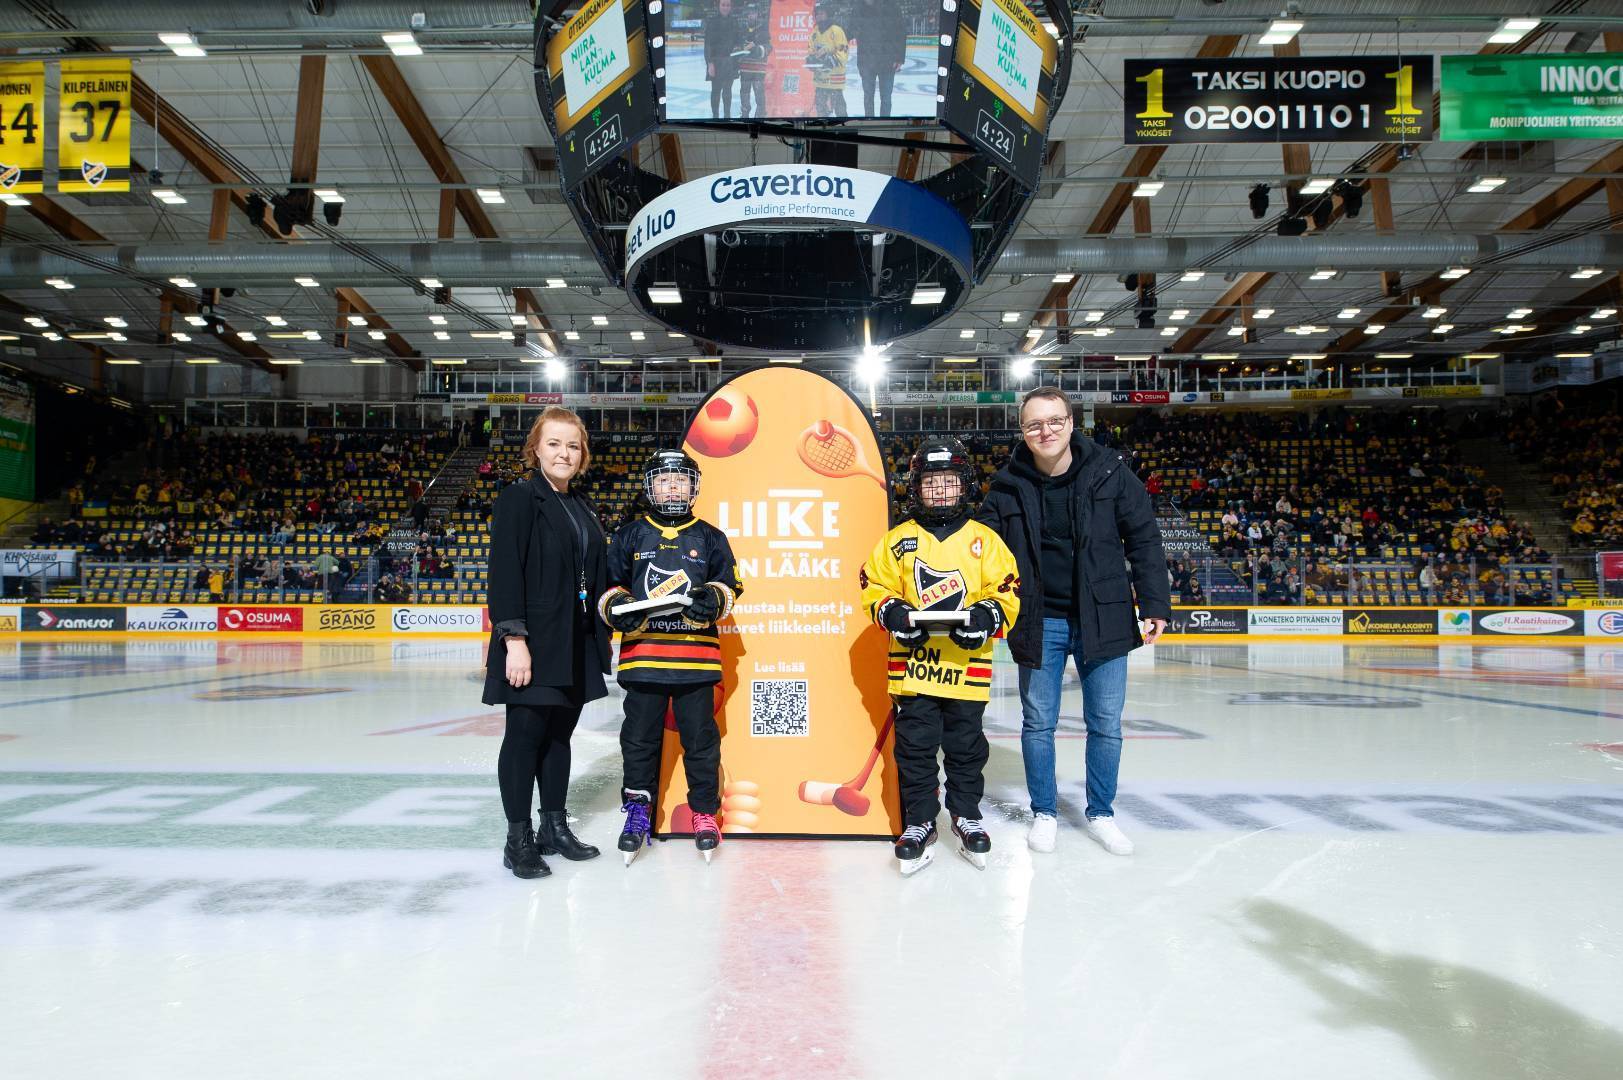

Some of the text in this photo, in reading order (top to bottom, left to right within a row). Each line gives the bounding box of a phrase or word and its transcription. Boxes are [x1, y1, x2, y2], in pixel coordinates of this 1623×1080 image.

[991, 12, 1017, 46] NIIRA
[571, 34, 596, 64] NIIRA
[584, 51, 616, 85] KULMA
[997, 54, 1027, 90] KULMA
[1541, 66, 1623, 92] INNOC
[64, 79, 128, 94] KILPELÄINEN
[1192, 70, 1366, 90] TAKSI KUOPIO
[1385, 65, 1423, 115] 1
[626, 93, 632, 106] 1
[963, 87, 970, 101] 4
[1135, 68, 1173, 118] 1
[0, 103, 38, 144] 4
[70, 101, 120, 143] 37
[1136, 128, 1172, 137] YKKÖSET
[1385, 126, 1422, 134] YKKÖSET
[1490, 117, 1567, 128] MONIPUOLINEN
[589, 124, 617, 157] 4:24
[982, 121, 1010, 153] 4:24
[1023, 133, 1028, 146] 1
[710, 168, 855, 203] Caverion
[744, 203, 855, 217] Building Performance
[647, 209, 676, 241] luo
[718, 502, 840, 538] LIIKE
[739, 552, 840, 578] N LÄÄKE
[651, 574, 685, 599] KALPA
[921, 578, 959, 605] ALPA
[246, 612, 292, 623] OSUMA
[320, 614, 375, 625] GRANO
[400, 611, 475, 625] ECONOSTO
[789, 600, 835, 618] lapset
[839, 601, 853, 618] ja
[1258, 615, 1295, 624] KONETEKO
[1296, 613, 1329, 624] PITKÄNEN
[127, 621, 217, 631] KAUKOKIITO
[768, 621, 846, 634] liikkeelle!
[754, 661, 805, 673] Lue lisää
[906, 662, 963, 685] NOMAT
